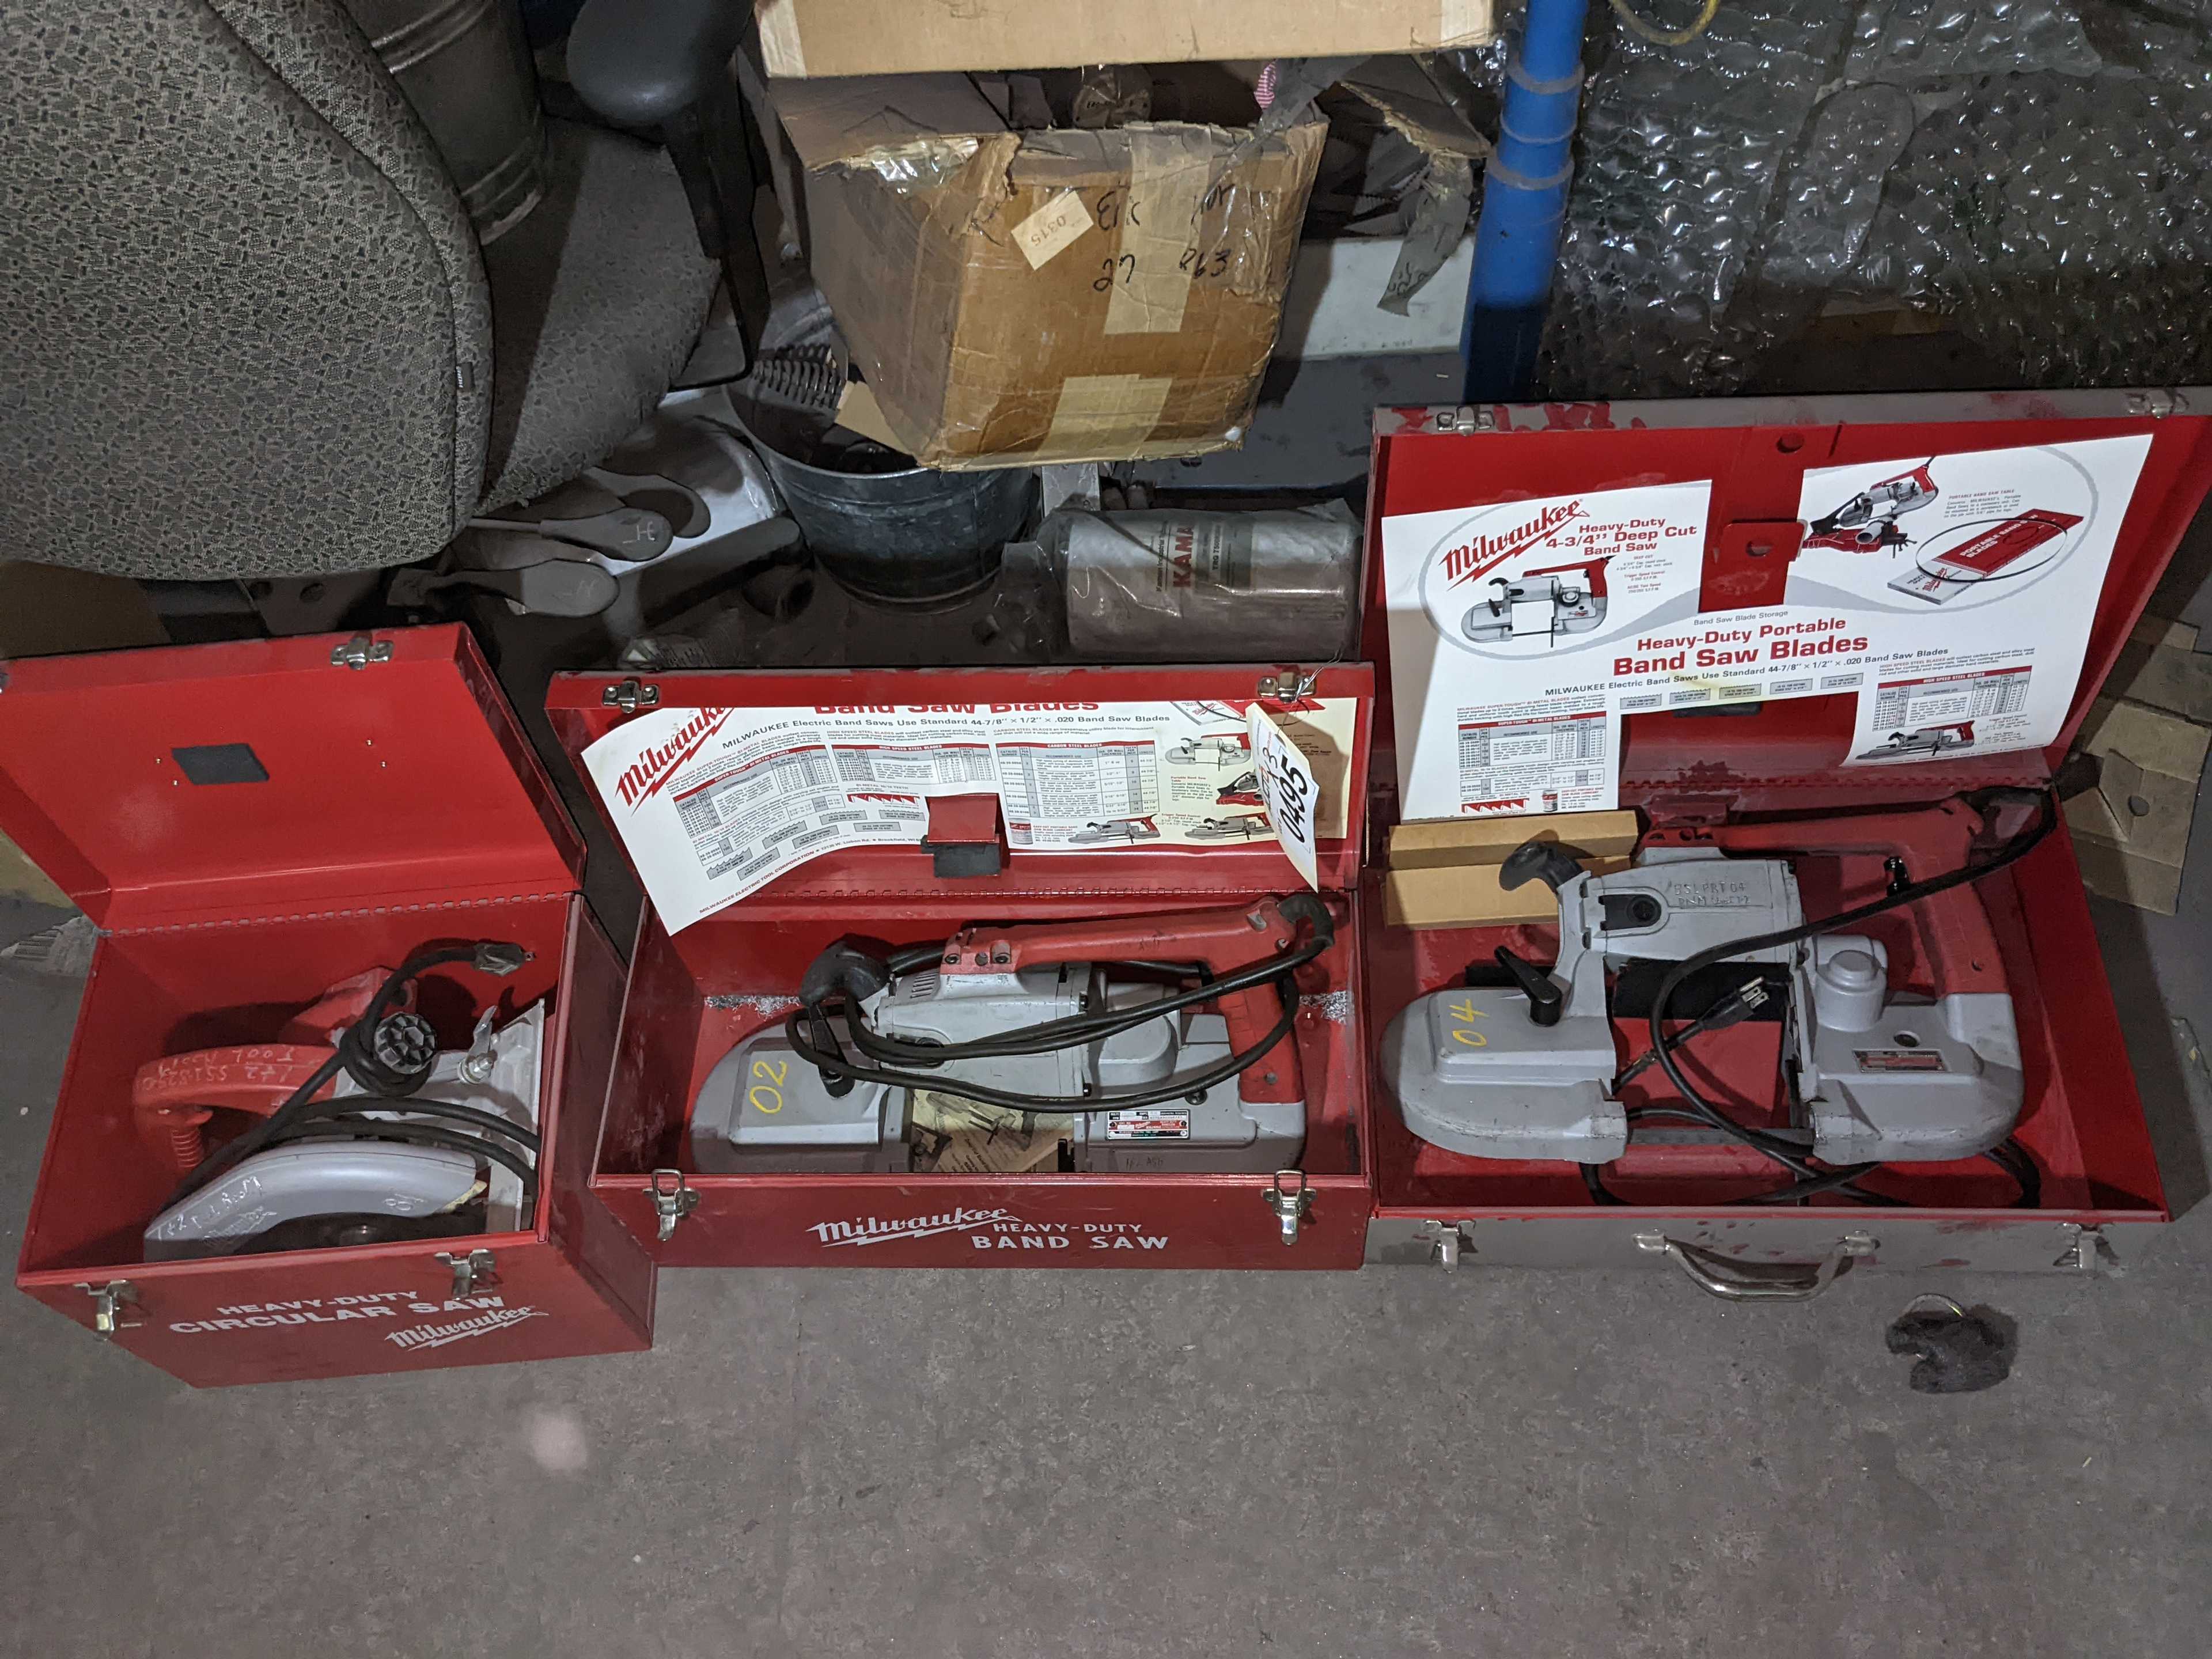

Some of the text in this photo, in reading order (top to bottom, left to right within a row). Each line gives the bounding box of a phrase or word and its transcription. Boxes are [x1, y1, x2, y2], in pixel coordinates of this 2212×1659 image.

[1438, 500, 1589, 589] Milwaukee
[1579, 518, 1666, 533] Heavy-Duty
[1614, 531, 1658, 543] Deep
[1665, 526, 1696, 537] Cut
[1584, 542, 1657, 555] Band Saw
[1637, 618, 1846, 651] Heavy-Duty Portable
[1759, 611, 1788, 619] Storage
[1545, 684, 1605, 696] MILWAUKEE
[1609, 680, 1642, 689] Electric
[1647, 677, 1670, 685] Band
[1673, 675, 1698, 683] Saws
[1723, 667, 1764, 678] Standard
[1865, 655, 1889, 663] Band
[1916, 648, 1948, 657] Blades
[1613, 635, 1868, 676] Band Saw Blades
[721, 721, 789, 749] MILWAUKEE
[793, 719, 832, 727] Electric
[615, 707, 728, 811] Milwauk
[1278, 755, 1308, 843] 0495
[699, 895, 735, 913] MILWAUKEE
[734, 879, 762, 896] ELECTRIC
[760, 871, 775, 881] TOOL
[775, 850, 815, 873] CORPORATION
[1449, 998, 1490, 1046] 04
[750, 1060, 788, 1114] 02
[806, 1207, 1018, 1247] Milwaukee
[971, 1235, 1169, 1249] BAND SAW
[993, 1223, 1142, 1233] HEAVY-DUTY
[171, 1296, 505, 1334] CIRCULAR SAW
[217, 1290, 421, 1315] HEAVY-DUTY
[385, 1305, 544, 1349] Milwaukee
